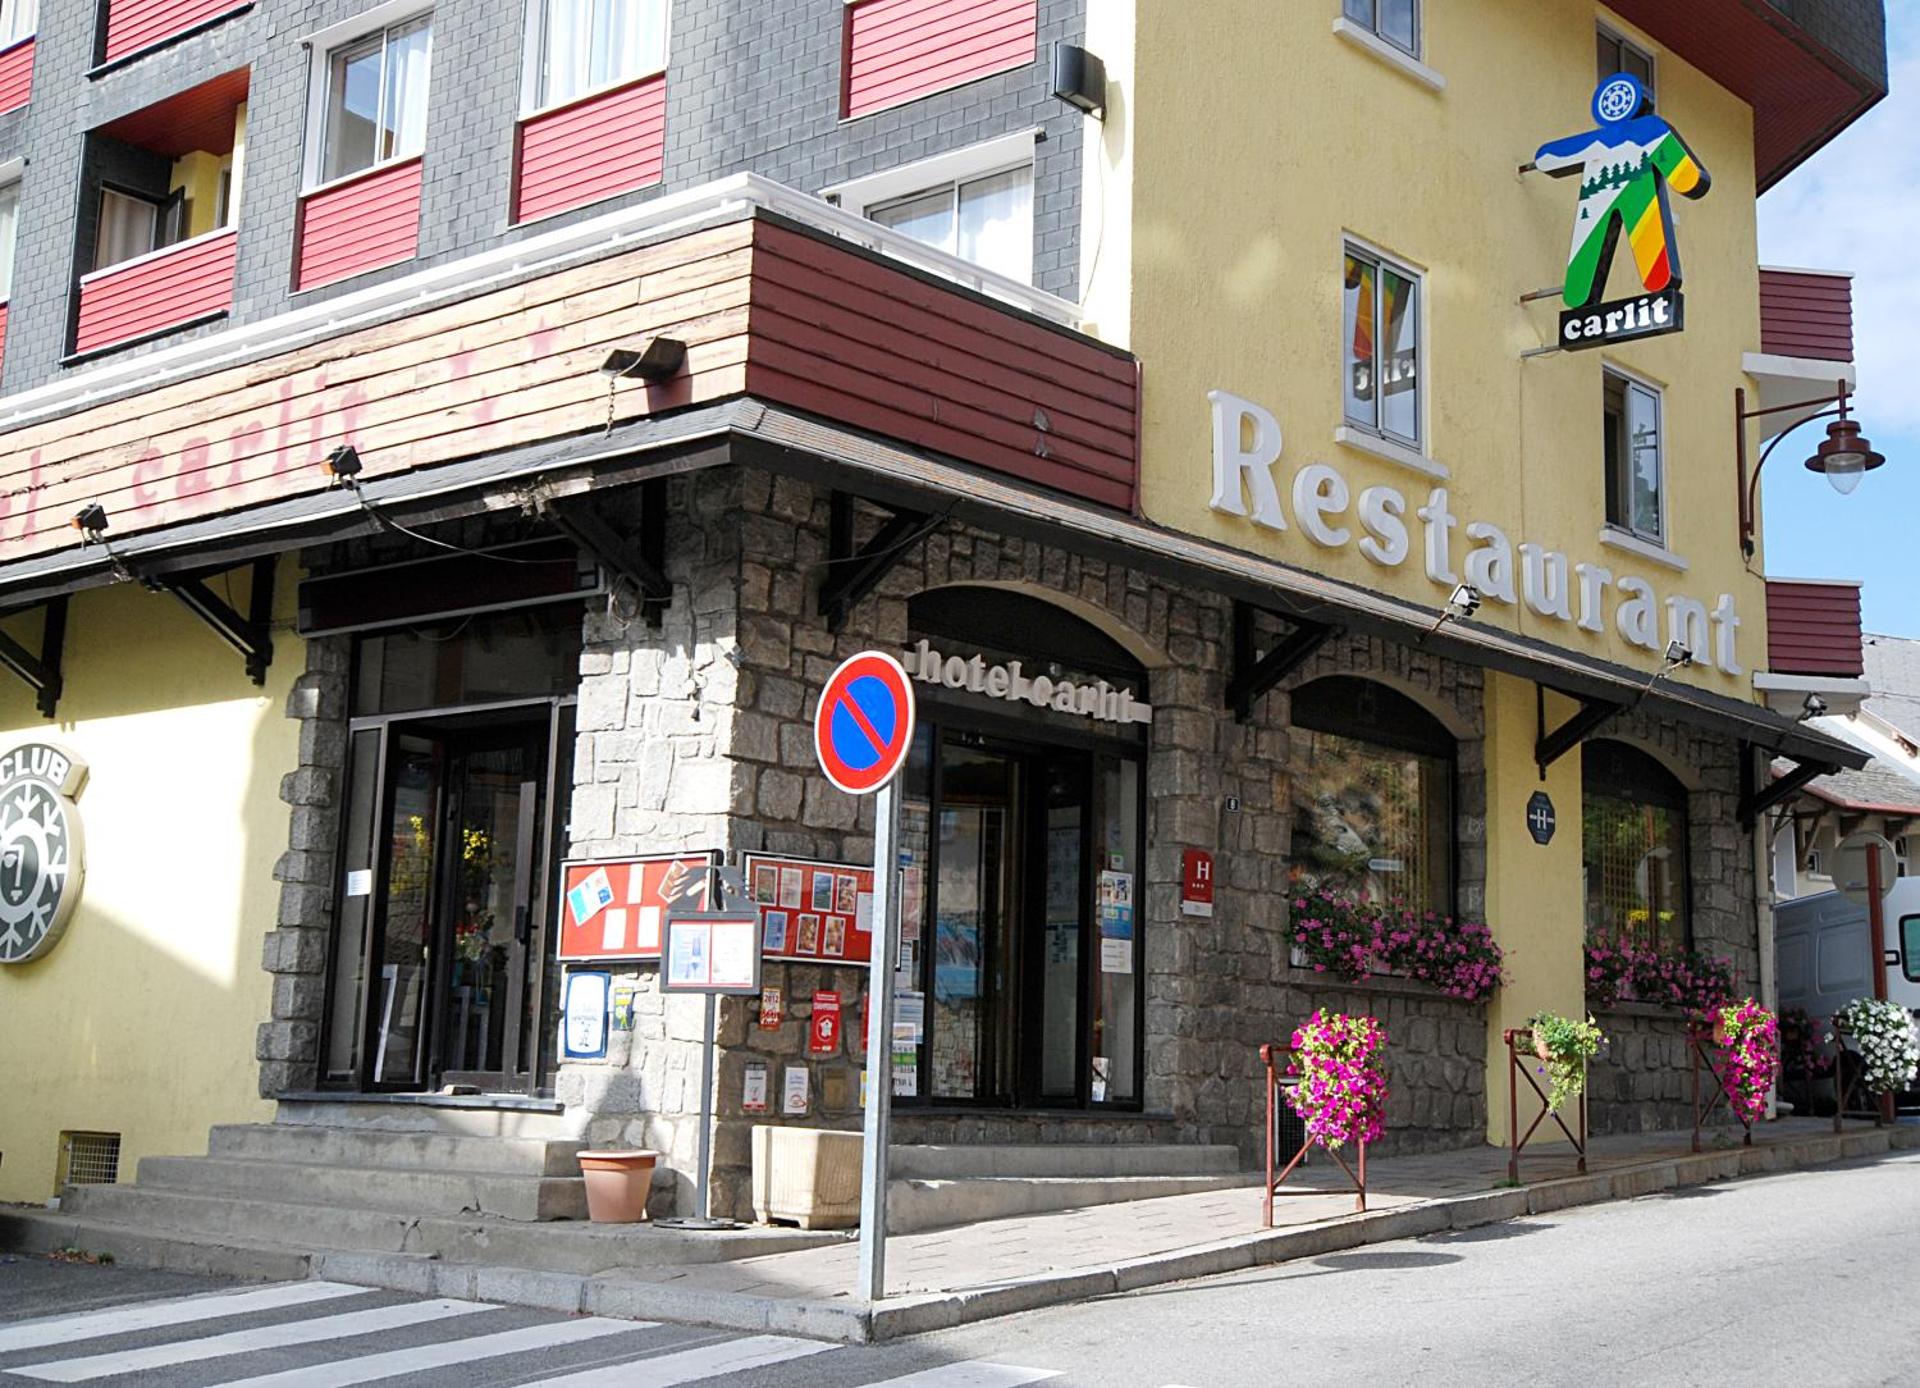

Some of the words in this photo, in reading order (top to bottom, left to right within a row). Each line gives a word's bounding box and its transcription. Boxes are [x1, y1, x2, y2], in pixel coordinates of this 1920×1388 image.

[1563, 297, 1669, 340] carlit
[131, 375, 368, 513] carlit
[1208, 389, 1742, 675] Restaurant
[912, 638, 1022, 701] hotel
[0, 747, 69, 786] CLUB
[1536, 808, 1547, 830] H
[1197, 860, 1211, 881] H
